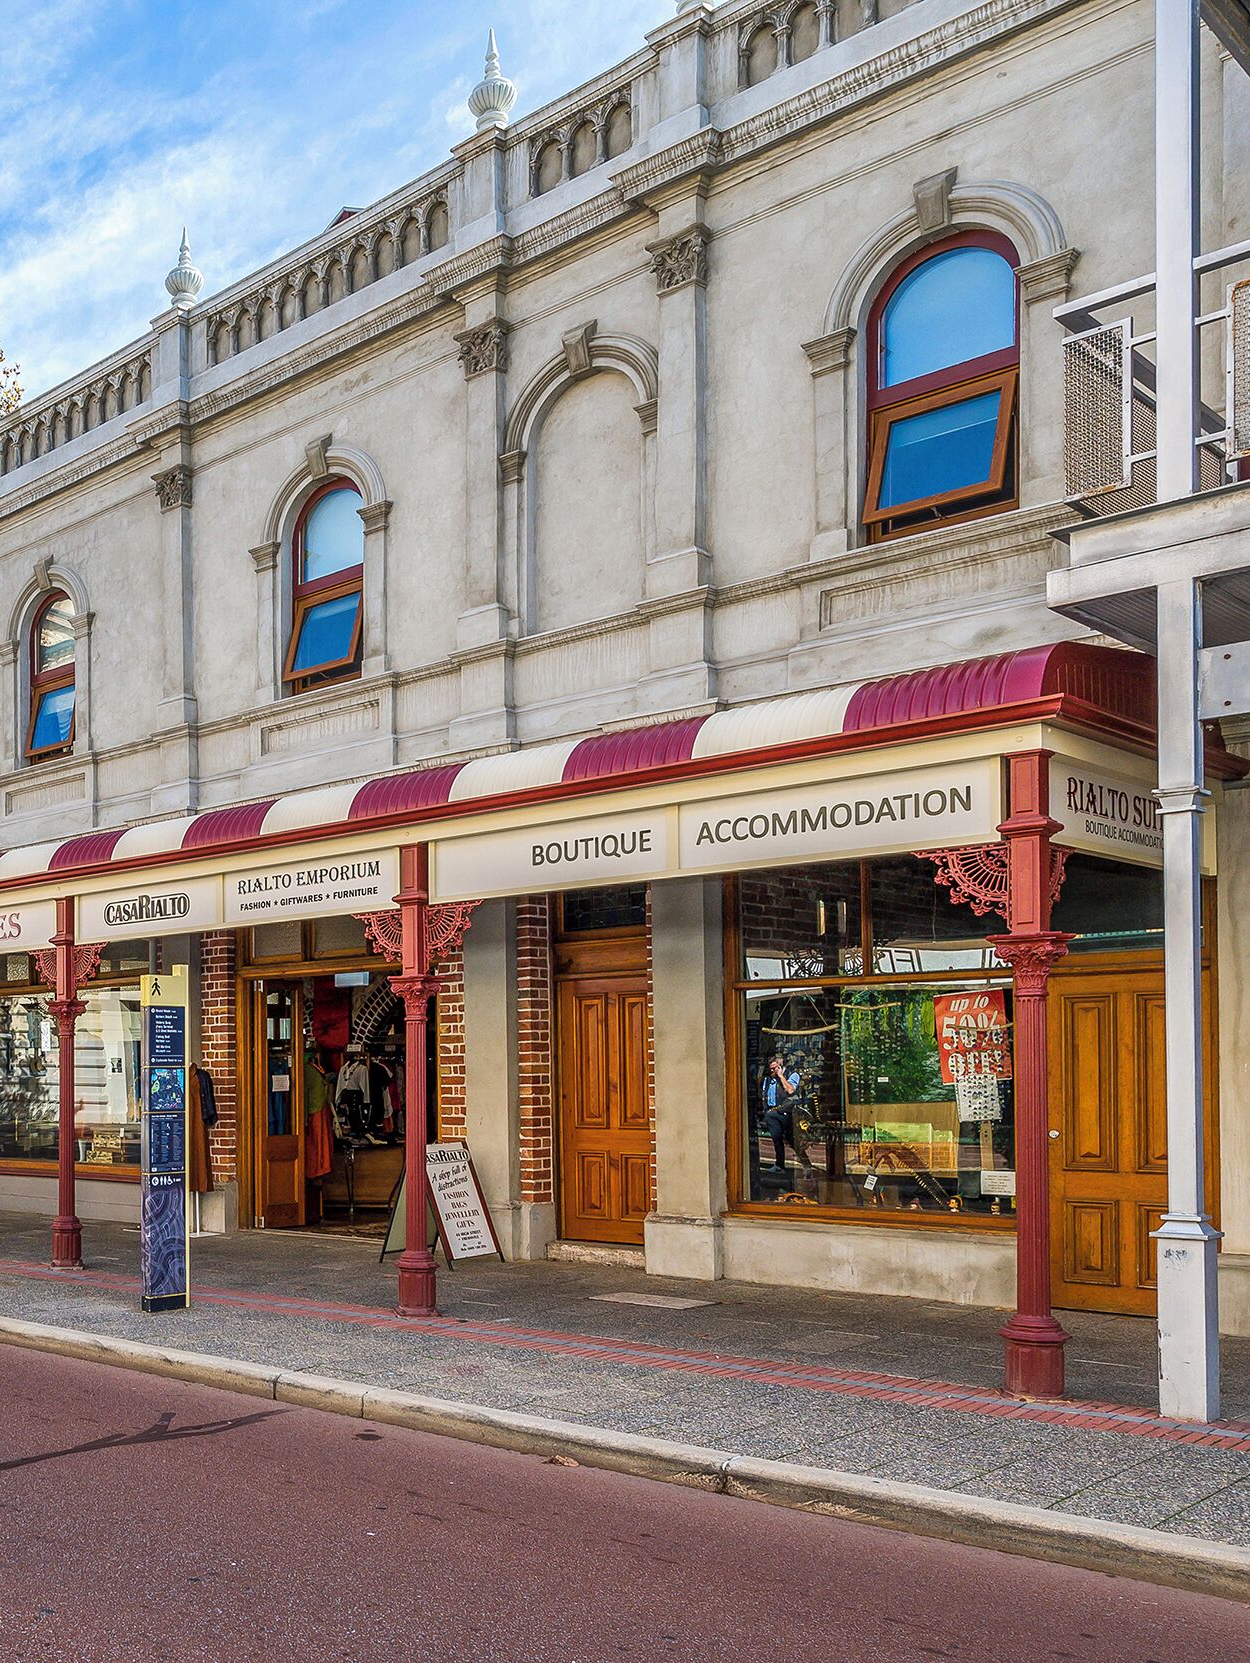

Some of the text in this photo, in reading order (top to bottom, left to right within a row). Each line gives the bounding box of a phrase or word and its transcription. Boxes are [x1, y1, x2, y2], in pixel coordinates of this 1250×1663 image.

[1066, 776, 1130, 824] RIALTO
[531, 785, 972, 867] BOUTIQUE ACCOMMODATION
[1085, 819, 1118, 840] BOUTIQUE
[238, 860, 382, 896] RIALTO EMPORIUM
[240, 886, 379, 912] FASHION GIFTWARES FURNITURE
[950, 994, 990, 1013] up to
[942, 1010, 1004, 1050] 50%
[426, 1149, 469, 1163] ASARIALTO
[442, 1190, 470, 1200] FASHION
[444, 1209, 480, 1221] JEWELLERY
[456, 1220, 476, 1228] GIFTS
